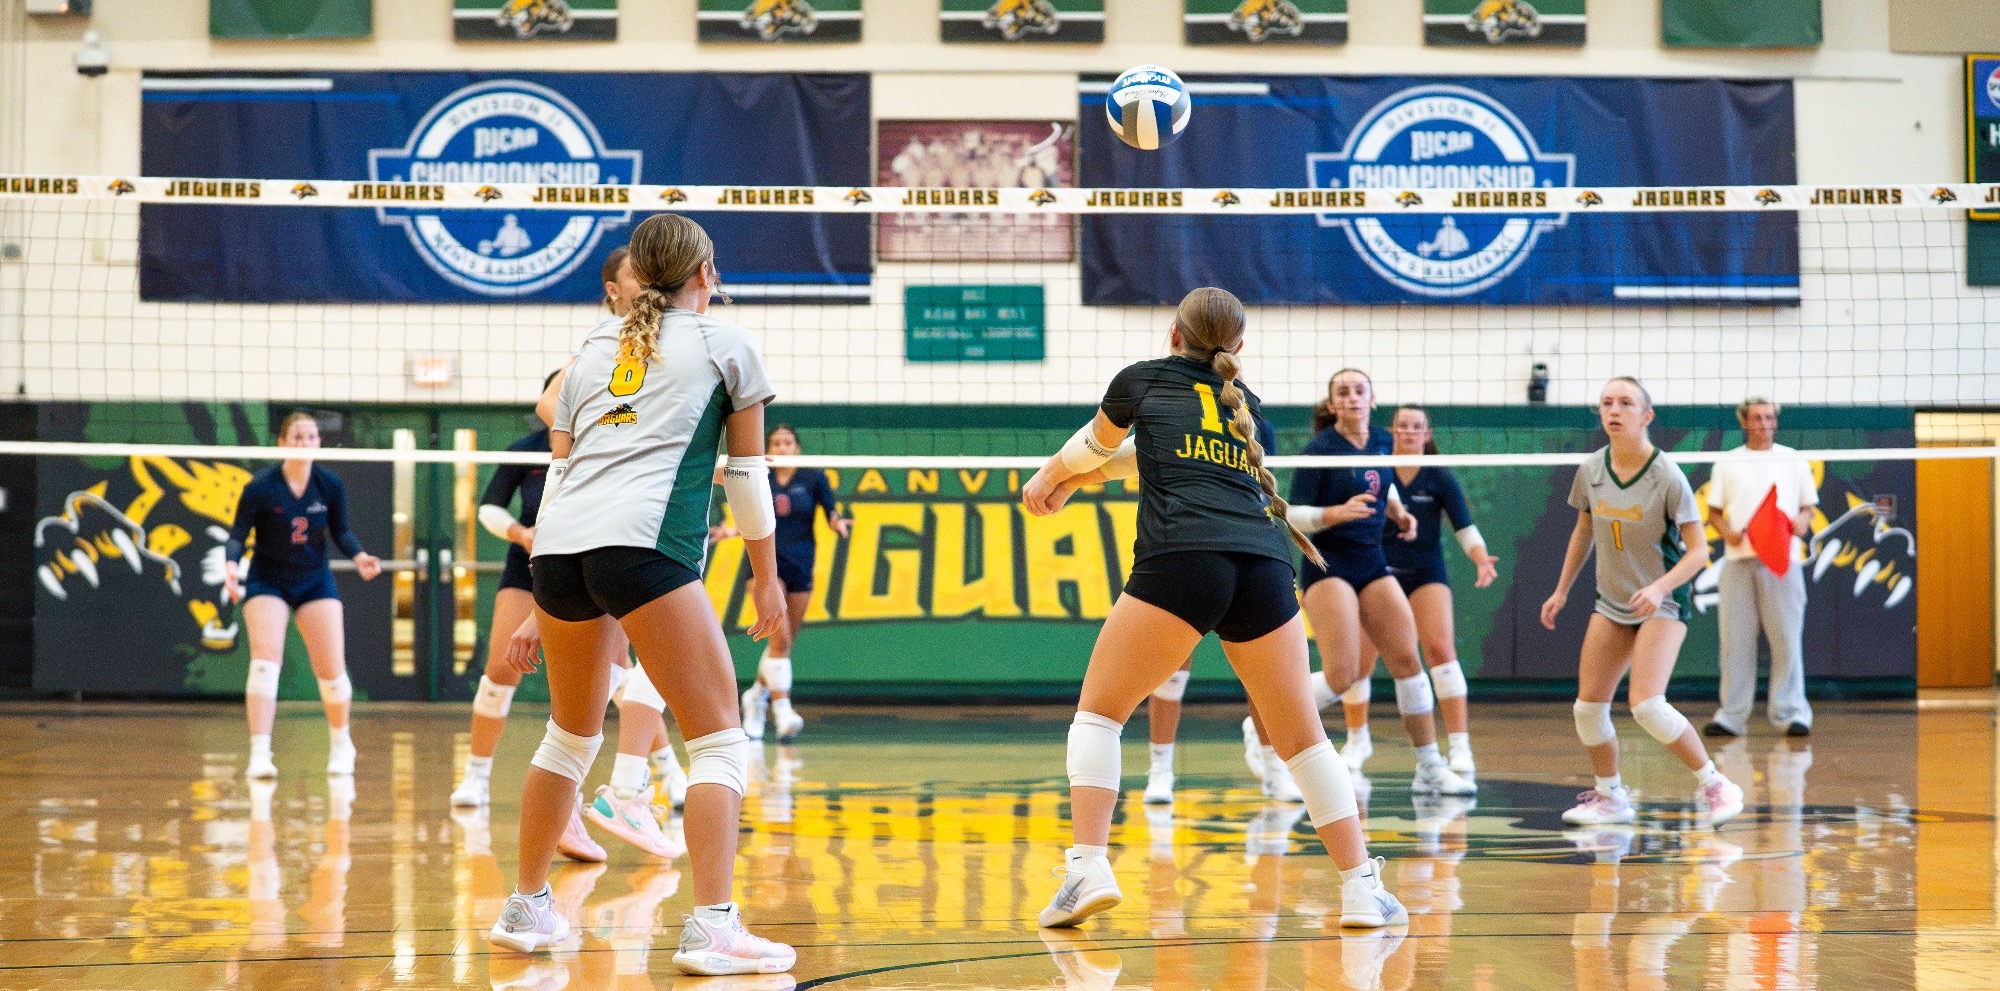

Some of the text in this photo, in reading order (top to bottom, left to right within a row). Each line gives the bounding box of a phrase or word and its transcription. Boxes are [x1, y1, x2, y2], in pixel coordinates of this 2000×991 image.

[165, 181, 261, 198] JAGUARS
[348, 184, 444, 201] JAGUARS
[532, 187, 630, 203] JAGUARS
[717, 189, 814, 205] JAGUARS
[902, 189, 998, 205] JAGUARS
[1086, 191, 1182, 207] JAGUARS
[1270, 191, 1366, 207] JAGUARS
[1453, 191, 1547, 207] JAGUARS
[1632, 190, 1725, 206] JAGUARS
[1810, 188, 1902, 205] JAGUARS
[598, 411, 638, 427] JAGUARS
[1365, 470, 1380, 497] 3
[291, 516, 309, 544] 2
[1611, 519, 1623, 552] 1
